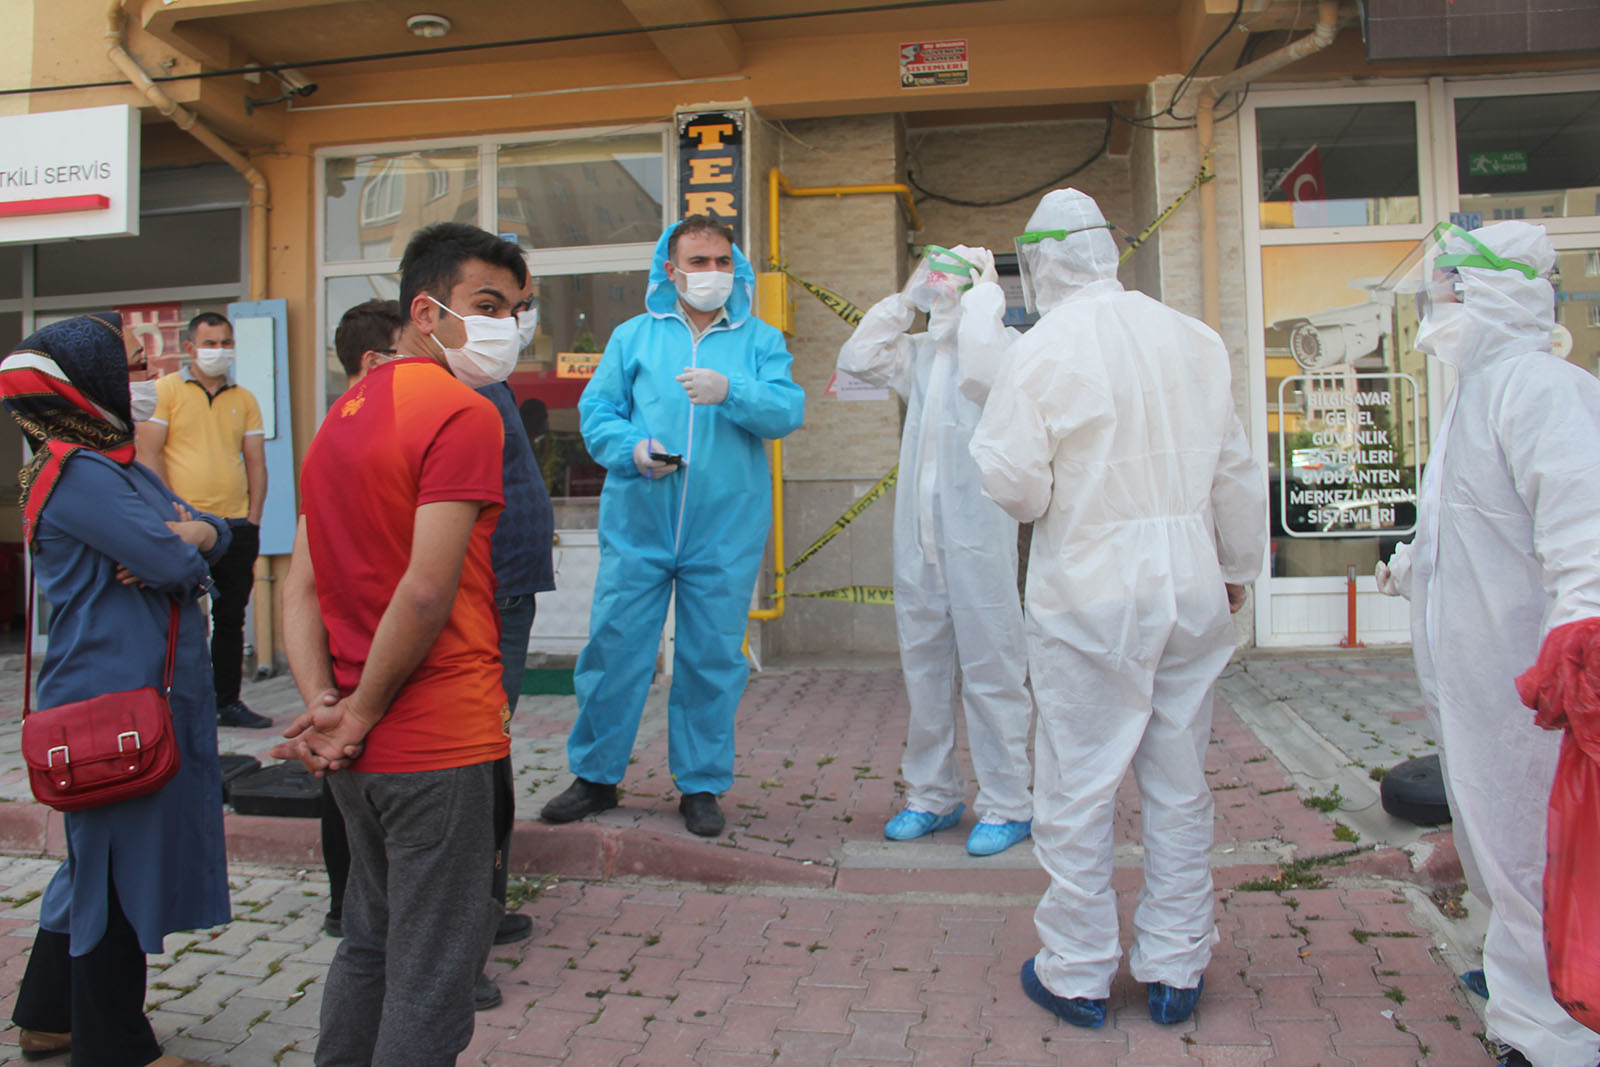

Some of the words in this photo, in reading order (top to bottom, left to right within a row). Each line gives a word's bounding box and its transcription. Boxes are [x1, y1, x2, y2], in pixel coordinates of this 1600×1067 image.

[44, 160, 111, 184] SERVİS
[684, 123, 738, 231] TER
[1308, 387, 1391, 406] BİLGİSAYAR
[1326, 411, 1375, 425] GENEL
[1349, 469, 1400, 484] ANTEN
[1361, 488, 1414, 503] ANTEN
